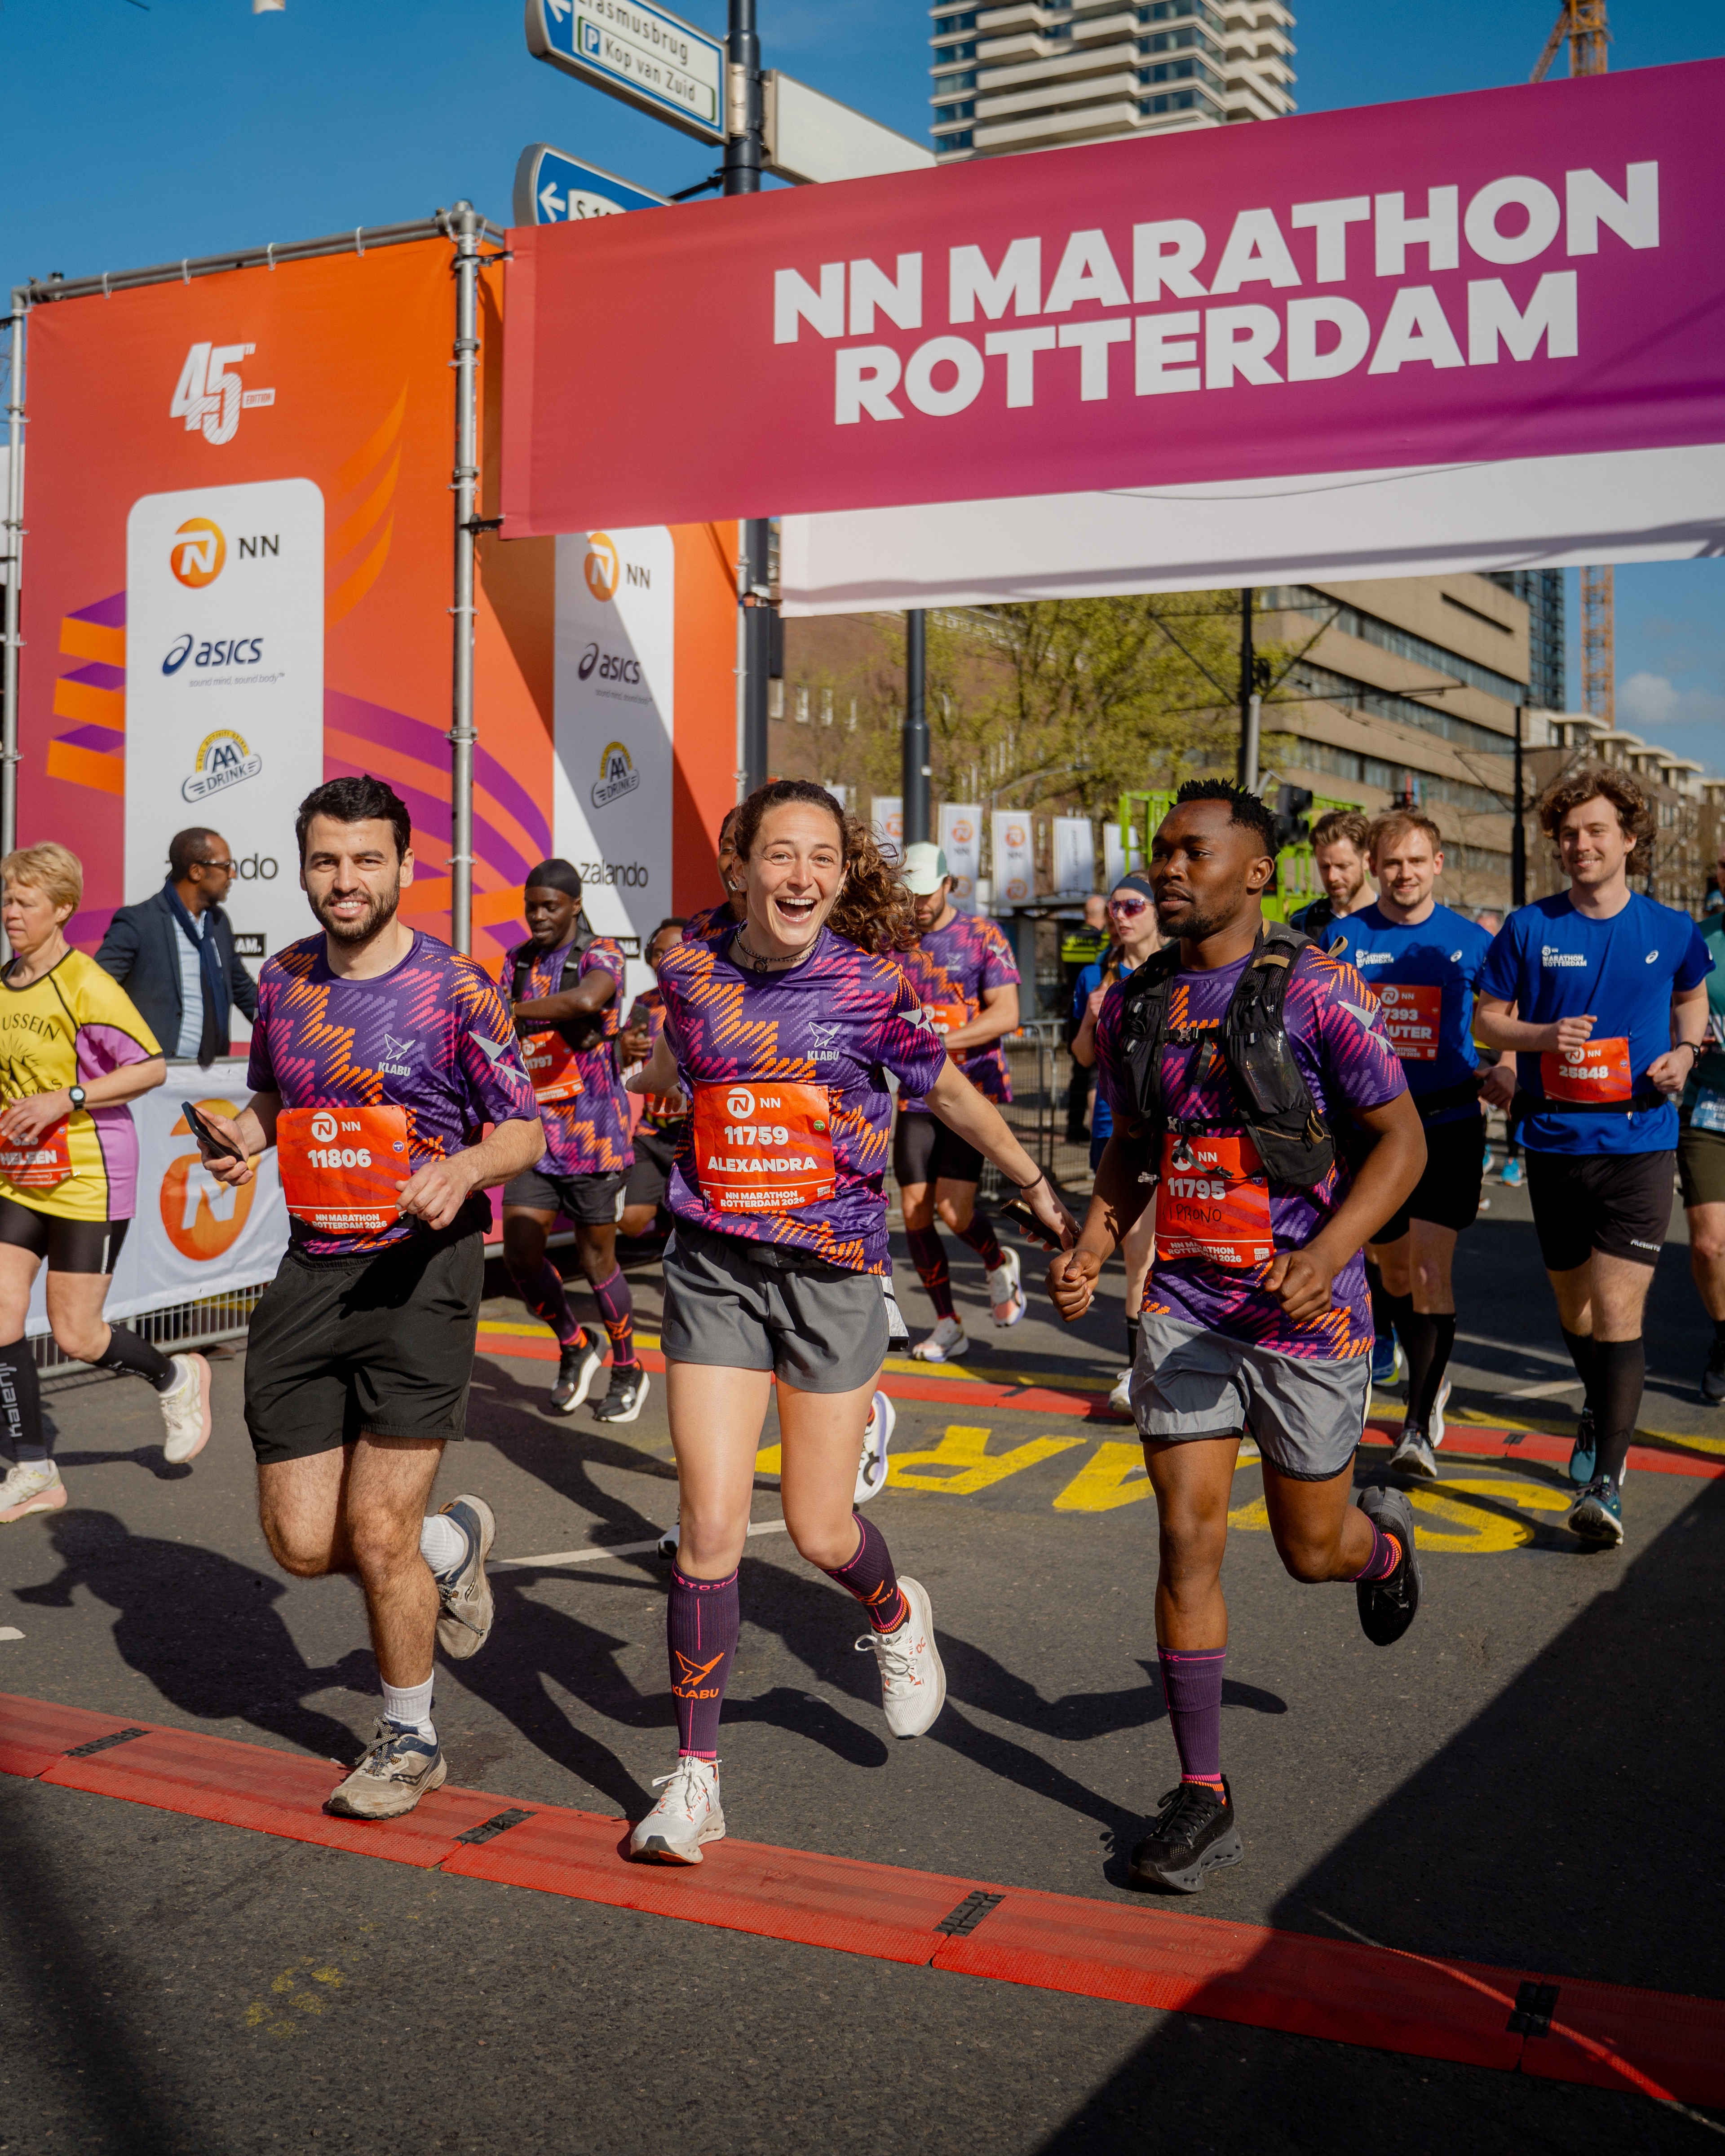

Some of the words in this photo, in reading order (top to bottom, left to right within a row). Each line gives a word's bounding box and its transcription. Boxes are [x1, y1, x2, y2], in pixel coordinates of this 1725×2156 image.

[578, 0, 688, 65] rasmusbrug
[605, 37, 632, 72] Kop
[635, 57, 660, 84] van
[666, 71, 695, 102] Zuid
[773, 252, 923, 345] NN
[949, 160, 1661, 324] MARATHON
[833, 270, 1579, 426] ROTTERDAM
[239, 535, 280, 560] NN
[626, 563, 650, 590] NN
[189, 678, 213, 688] sound
[234, 675, 258, 684] sound
[211, 745, 240, 774] AA
[207, 764, 247, 791] DRINK
[580, 858, 649, 888] zalando
[1542, 954, 1584, 962] MARATHON
[807, 1050, 840, 1061] KLABU
[378, 1062, 411, 1077] KLABU
[1559, 1065, 1609, 1080] 25848
[760, 1097, 781, 1109] NN
[341, 1121, 361, 1131] NN
[724, 1126, 788, 1146] 11759
[0, 1149, 58, 1166] HELEEN
[308, 1148, 372, 1168] 11806
[708, 1156, 818, 1173] ALEXANDRA
[1198, 1151, 1217, 1162] NN
[725, 1192, 739, 1200] NN
[741, 1190, 798, 1200] MARATHON
[1168, 1177, 1226, 1200] 11795
[720, 1198, 780, 1208] ROTTERDAM
[782, 1197, 805, 1206] 2026
[312, 1221, 364, 1229] ROTTERDAM
[365, 1220, 388, 1229] 2026
[329, 1214, 380, 1222] MARATHON
[1219, 1255, 1242, 1263] 2026
[672, 1684, 719, 1700] KLABU
